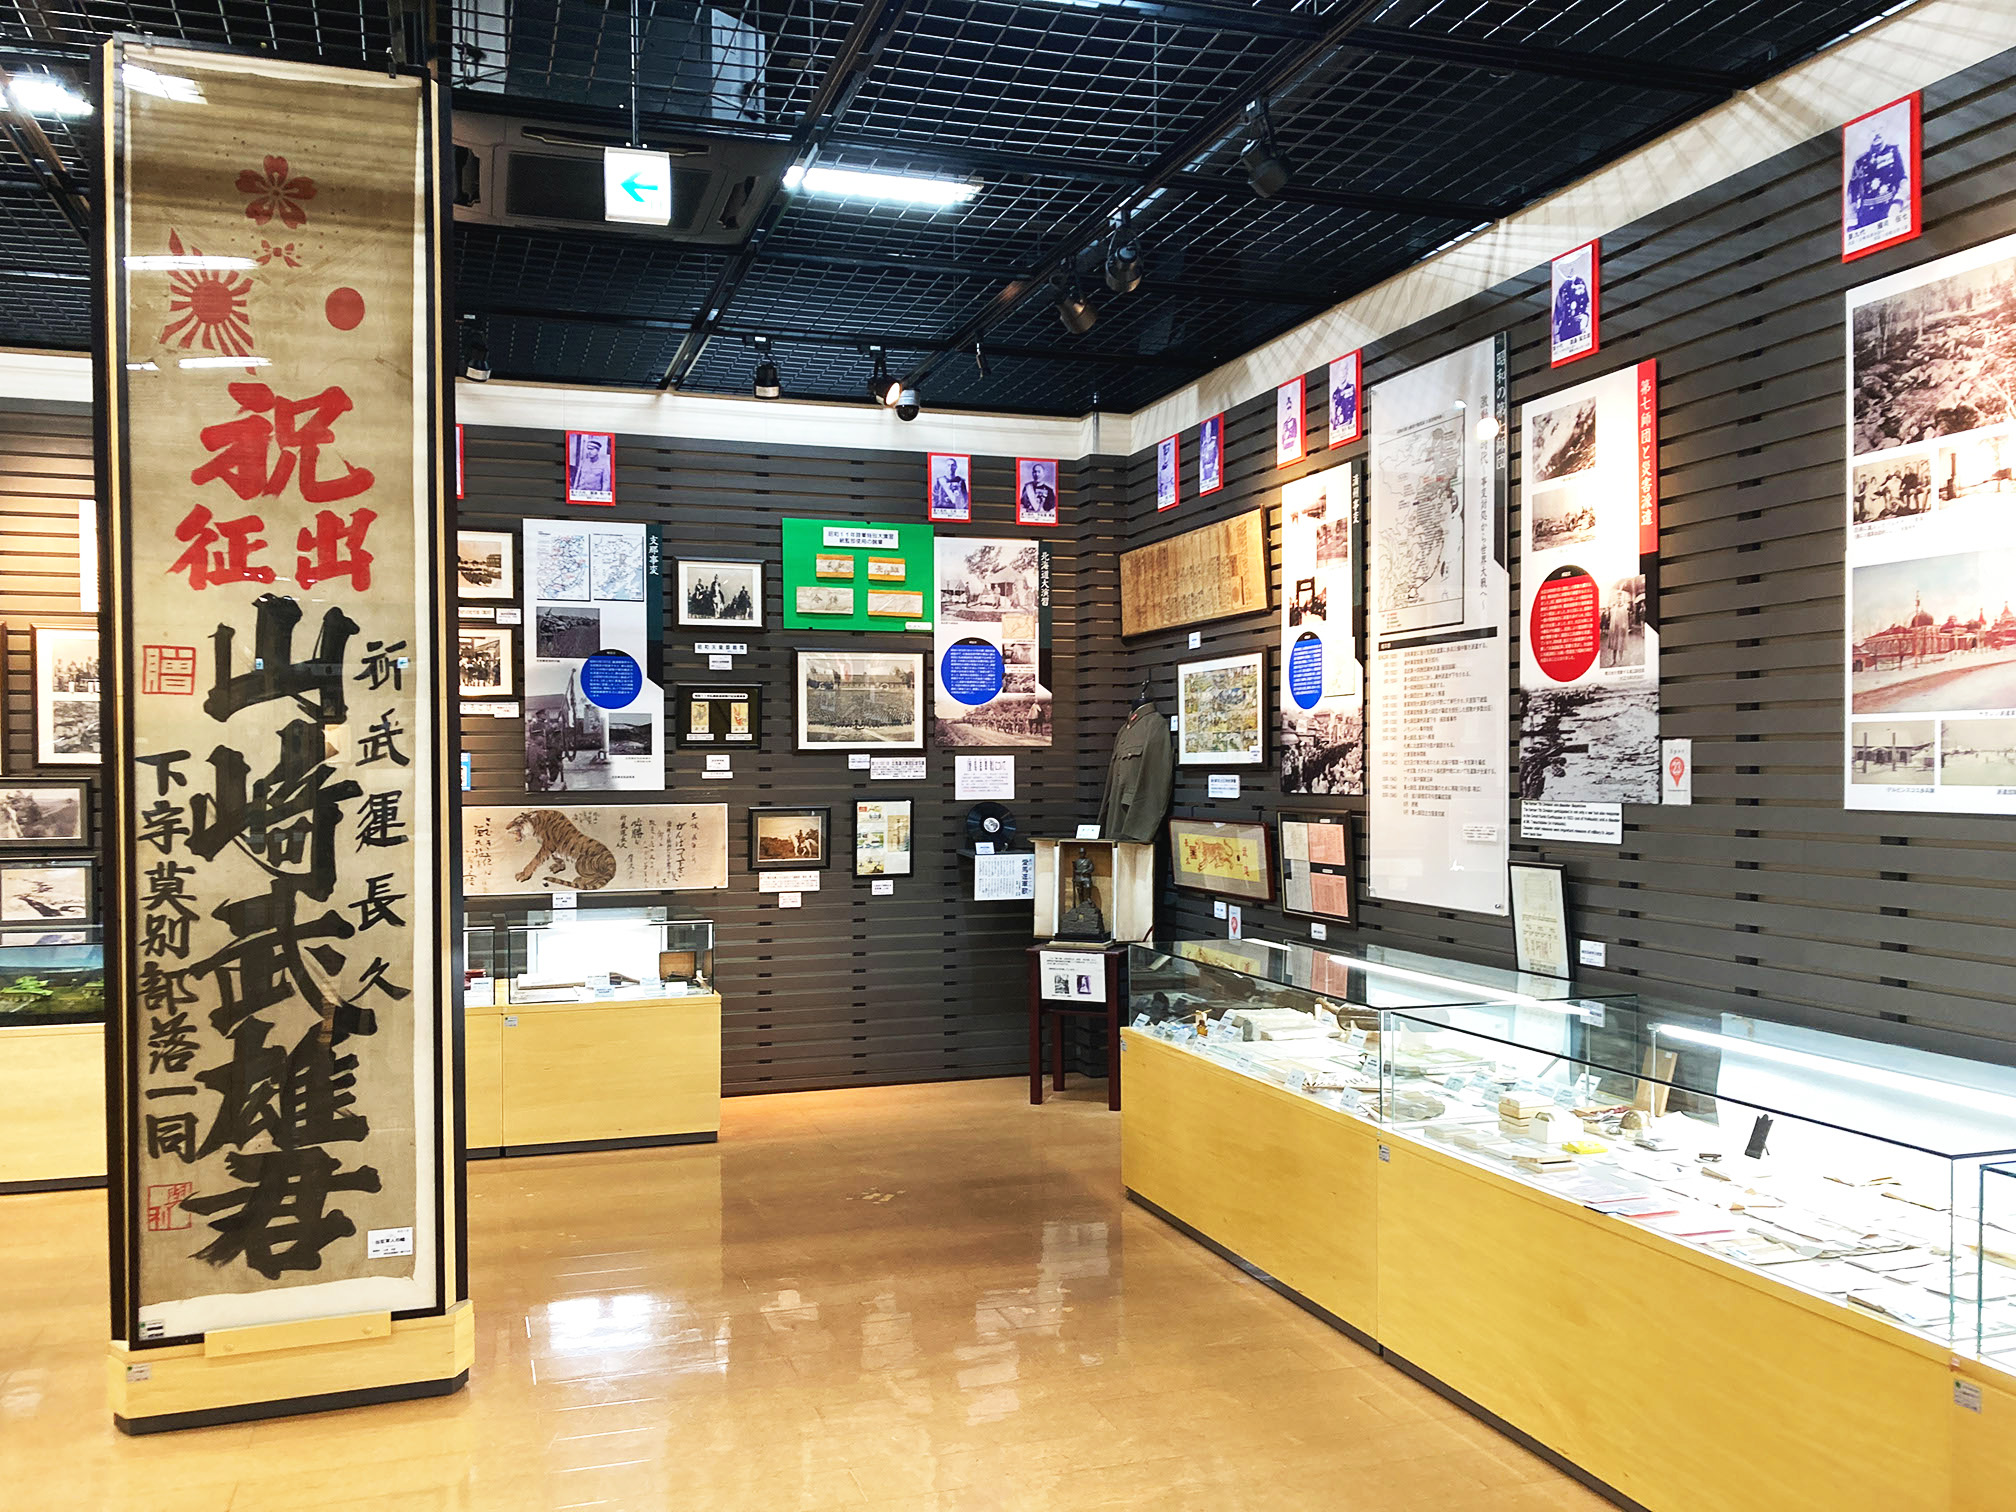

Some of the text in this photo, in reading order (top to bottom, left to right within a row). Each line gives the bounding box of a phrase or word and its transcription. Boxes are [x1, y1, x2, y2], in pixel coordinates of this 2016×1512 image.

[190, 382, 375, 502] 祝
[1041, 551, 1050, 607] 北海道大演習
[349, 640, 411, 1002] 祈武運長久
[135, 749, 200, 1164] 下宇莫別部落一同
